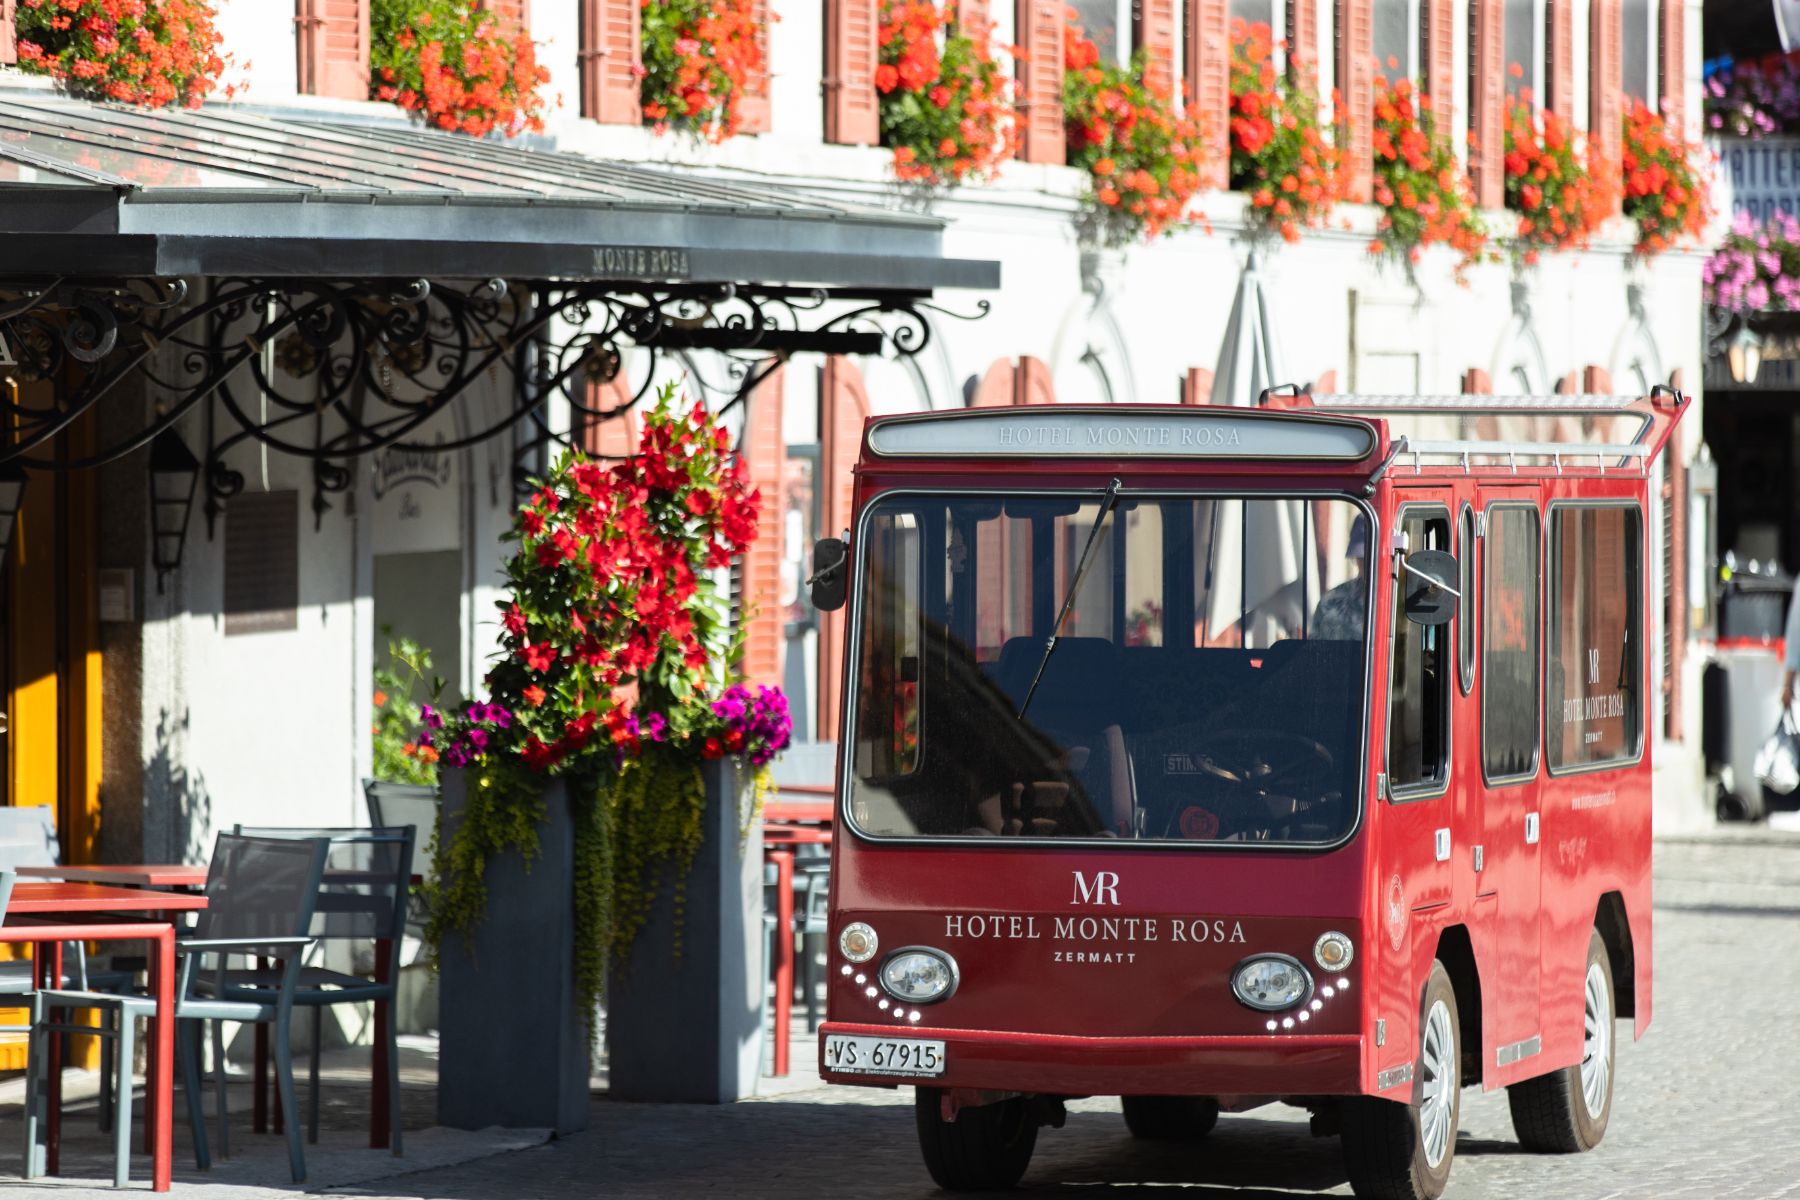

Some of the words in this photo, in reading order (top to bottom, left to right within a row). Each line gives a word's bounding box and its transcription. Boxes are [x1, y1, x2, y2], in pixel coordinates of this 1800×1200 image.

[592, 247, 646, 275] MONTE
[650, 249, 689, 274] ROSA
[999, 427, 1075, 445] HOTEL
[1086, 427, 1170, 446] MONTE
[1181, 428, 1240, 446] ROSA
[1563, 698, 1584, 723] HOTEL
[1585, 695, 1607, 720] MONTE
[1608, 693, 1624, 718] ROSA
[1070, 871, 1121, 906] MR
[944, 915, 1041, 939] HOTEL
[1053, 917, 1158, 942] MONTE
[1171, 919, 1247, 944] ROSA
[1054, 951, 1136, 964] ZERMATT
[872, 1042, 937, 1069] 67915
